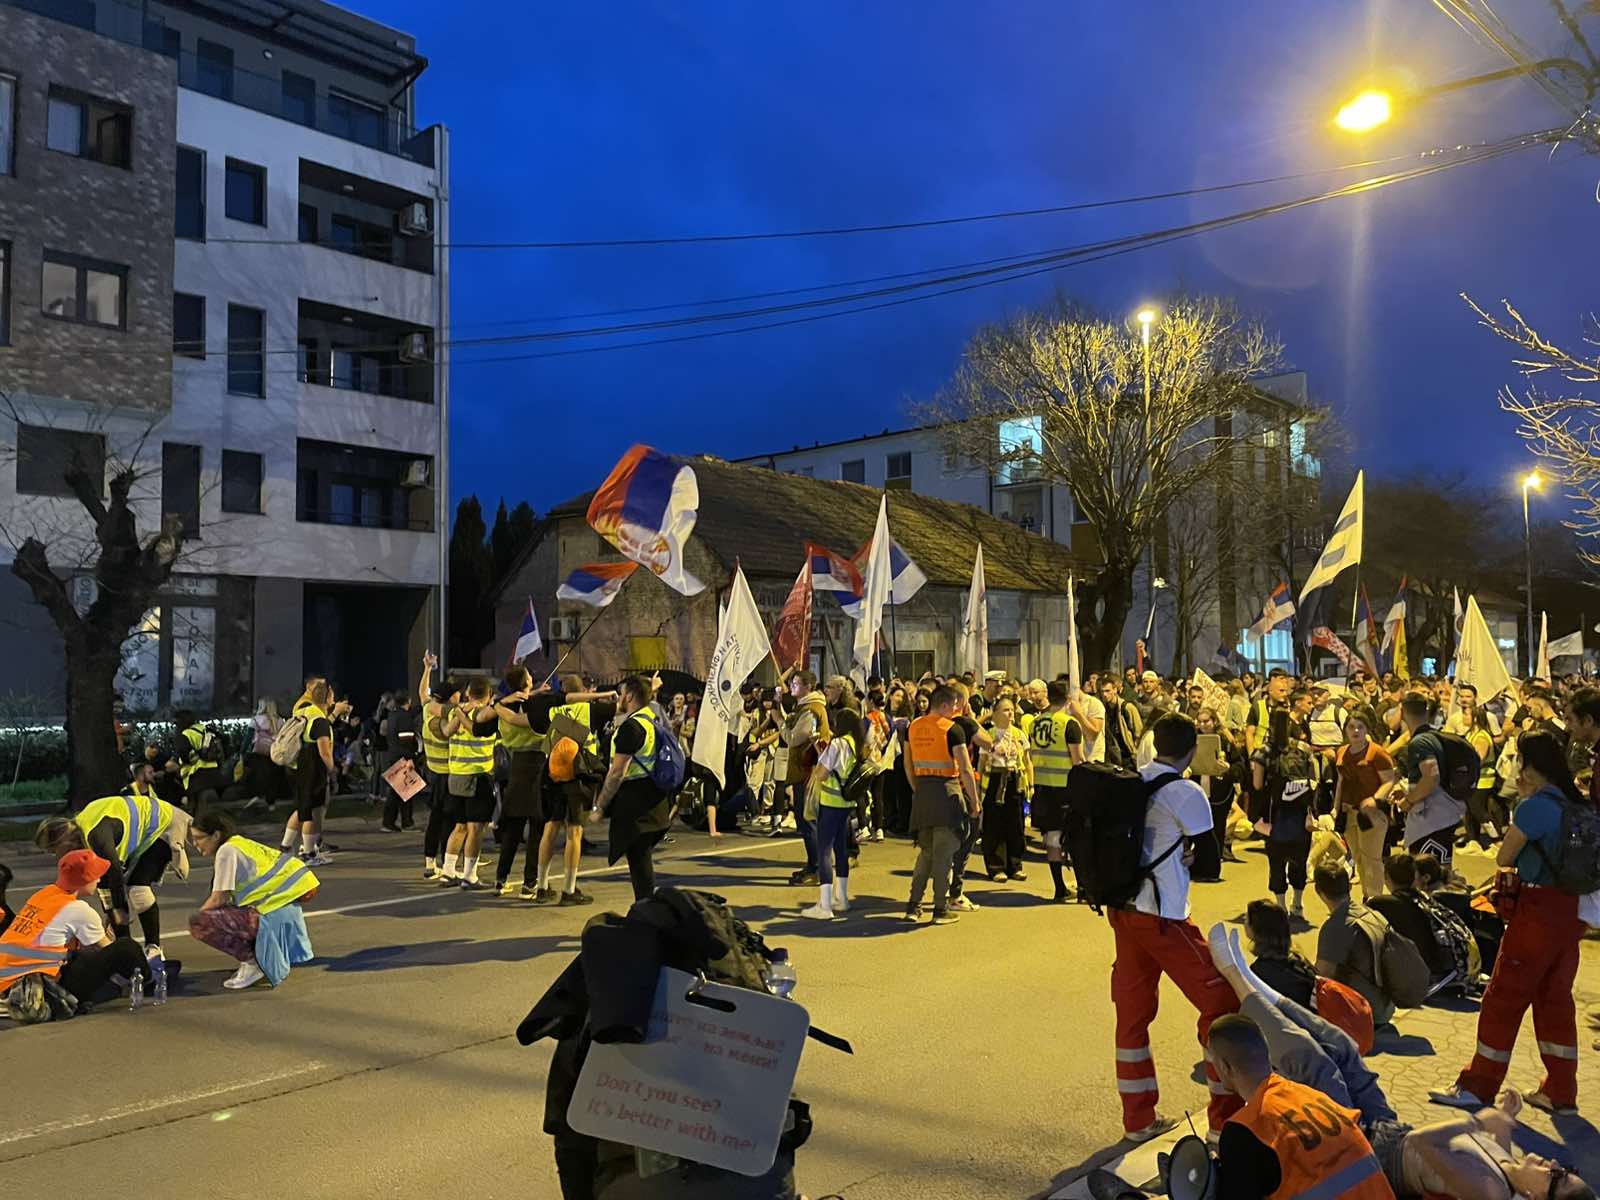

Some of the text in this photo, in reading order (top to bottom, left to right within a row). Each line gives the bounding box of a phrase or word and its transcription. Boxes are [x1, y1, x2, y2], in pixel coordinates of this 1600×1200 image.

[188, 609, 200, 686] LOKAL
[595, 1072, 722, 1112] Don't you see?
[588, 1097, 614, 1117] It's
[617, 1103, 672, 1130] better
[678, 1120, 717, 1144] with
